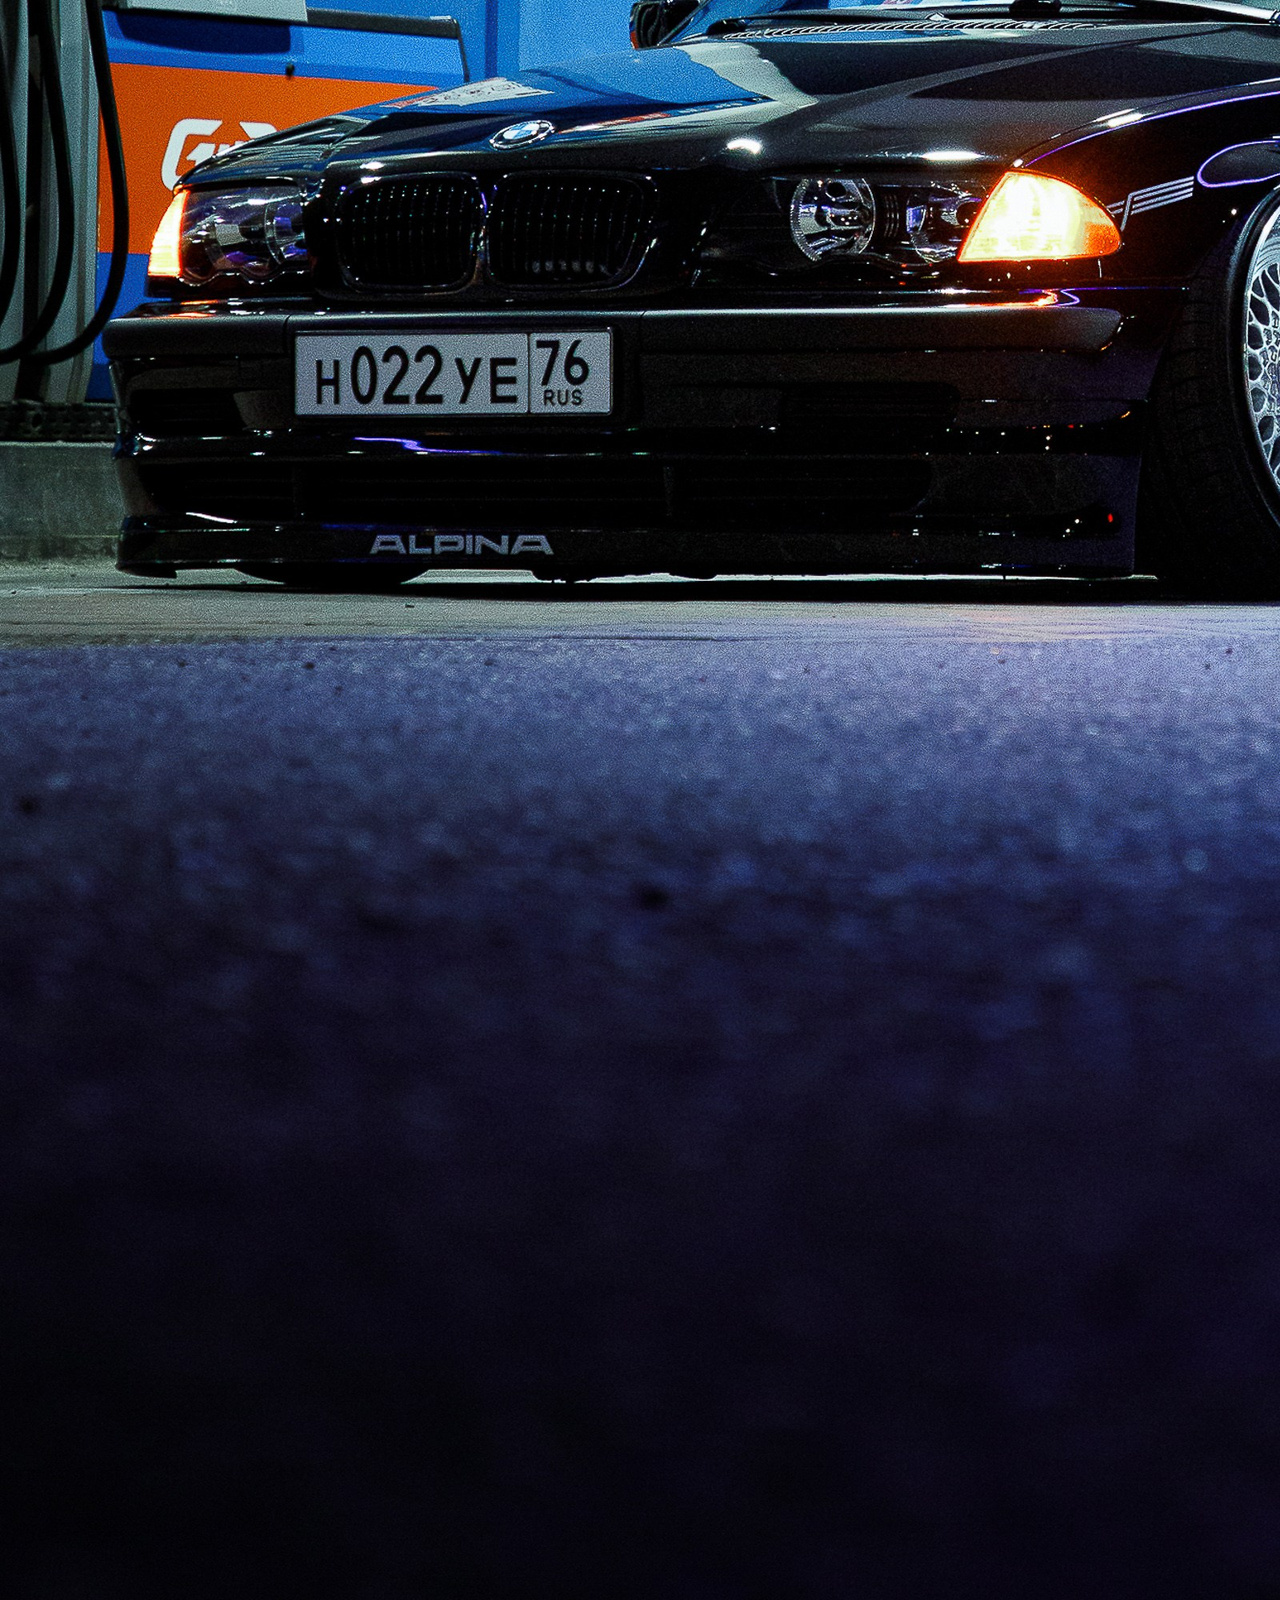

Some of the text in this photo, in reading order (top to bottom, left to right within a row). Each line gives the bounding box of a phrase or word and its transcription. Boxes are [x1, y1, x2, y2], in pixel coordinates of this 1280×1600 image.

[536, 340, 590, 386] 76
[543, 388, 583, 406] RUS
[369, 534, 554, 555] ALPINA
